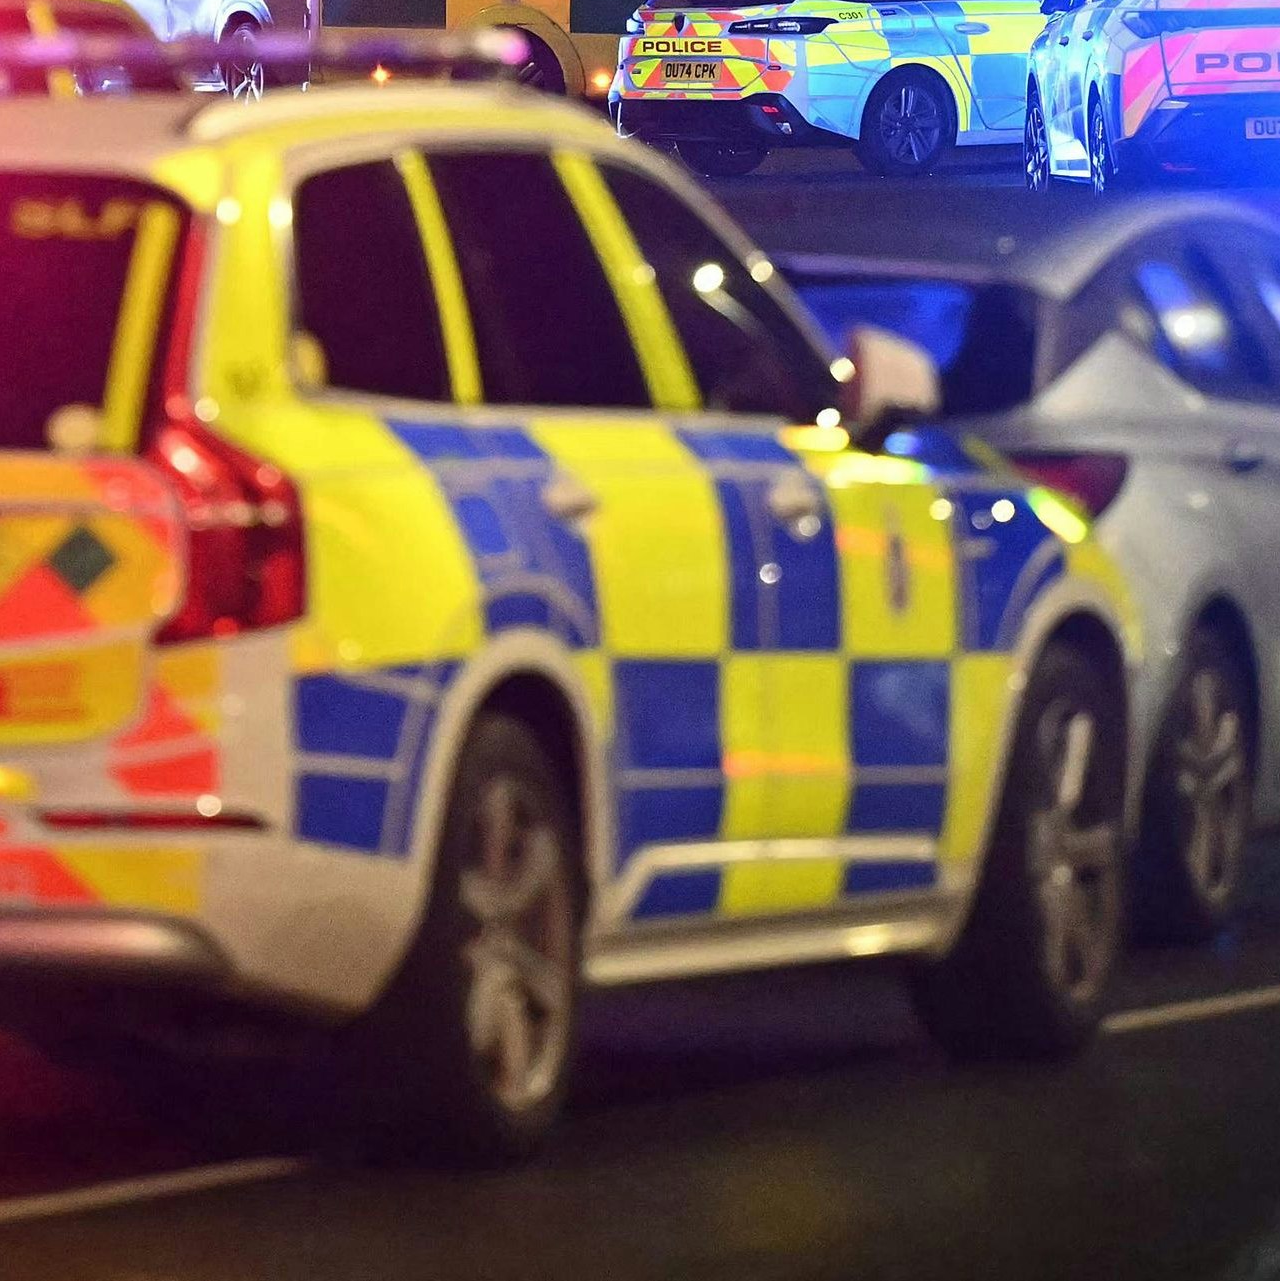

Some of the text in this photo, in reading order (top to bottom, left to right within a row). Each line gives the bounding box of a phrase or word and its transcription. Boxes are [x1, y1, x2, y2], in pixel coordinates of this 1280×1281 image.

[838, 11, 863, 20] C301
[642, 40, 722, 53] POLICE
[665, 62, 716, 79] OU74 CPK
